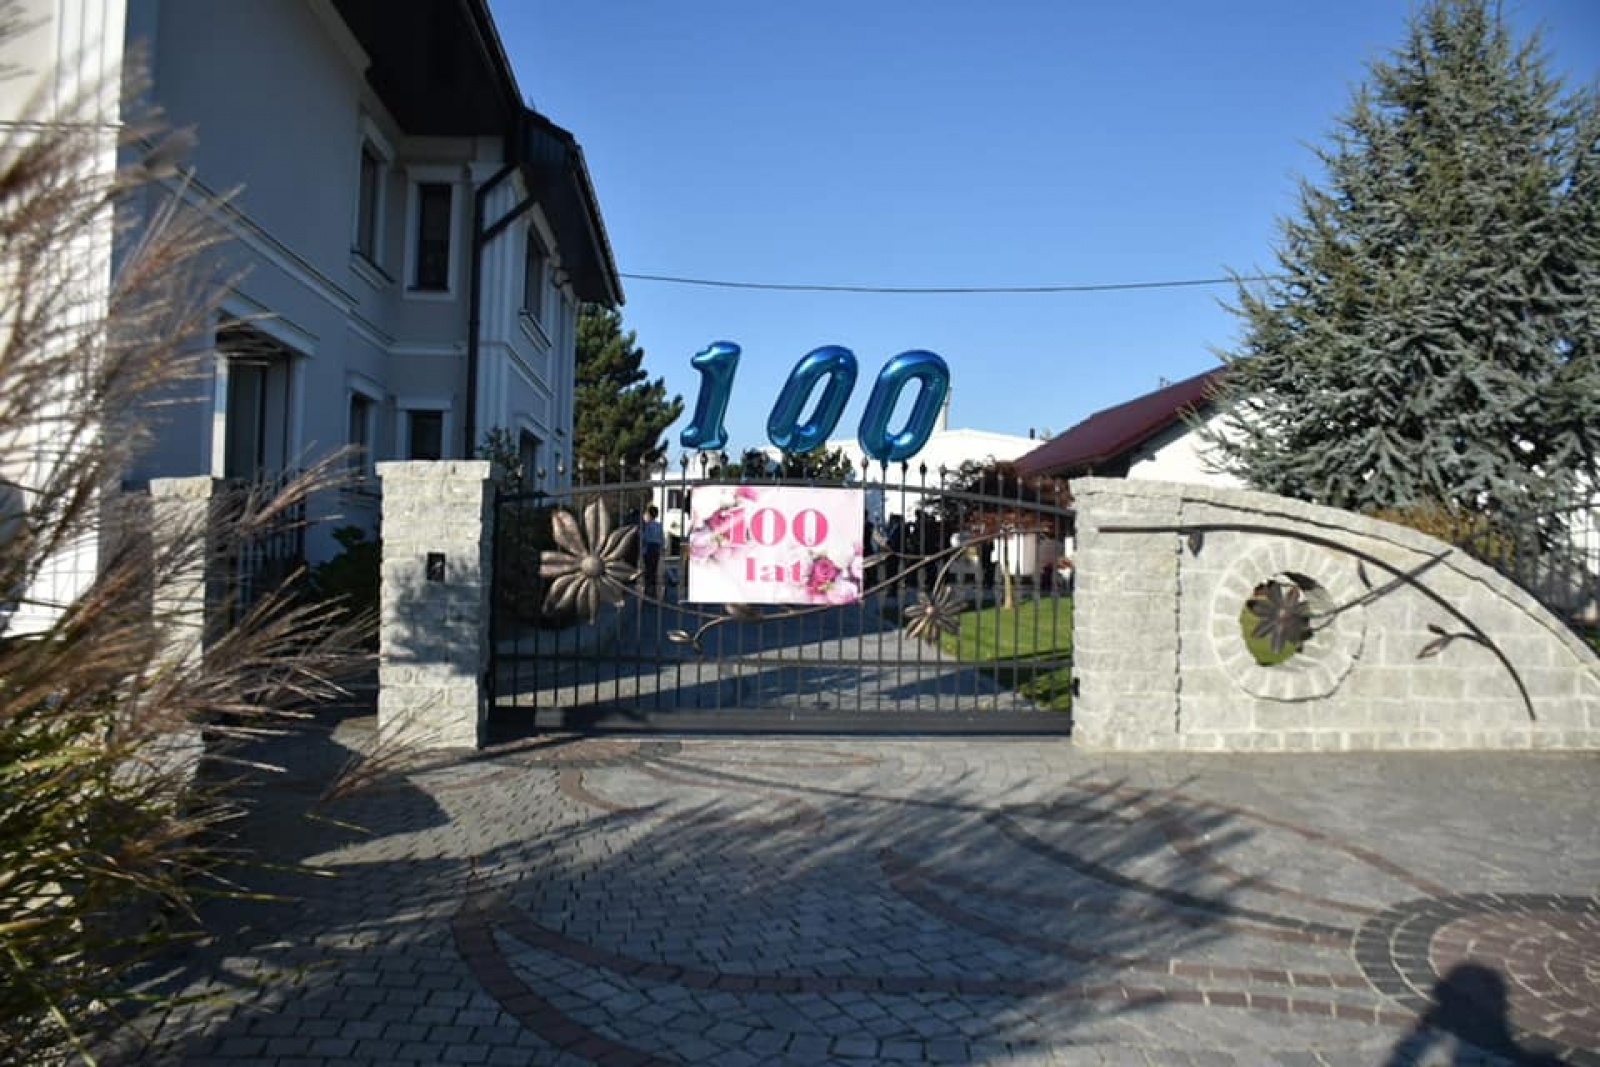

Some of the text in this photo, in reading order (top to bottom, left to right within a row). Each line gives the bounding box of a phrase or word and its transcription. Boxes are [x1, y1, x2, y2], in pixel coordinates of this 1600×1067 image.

[680, 340, 950, 462] 100
[727, 506, 829, 547] 100
[745, 557, 805, 583] lat
